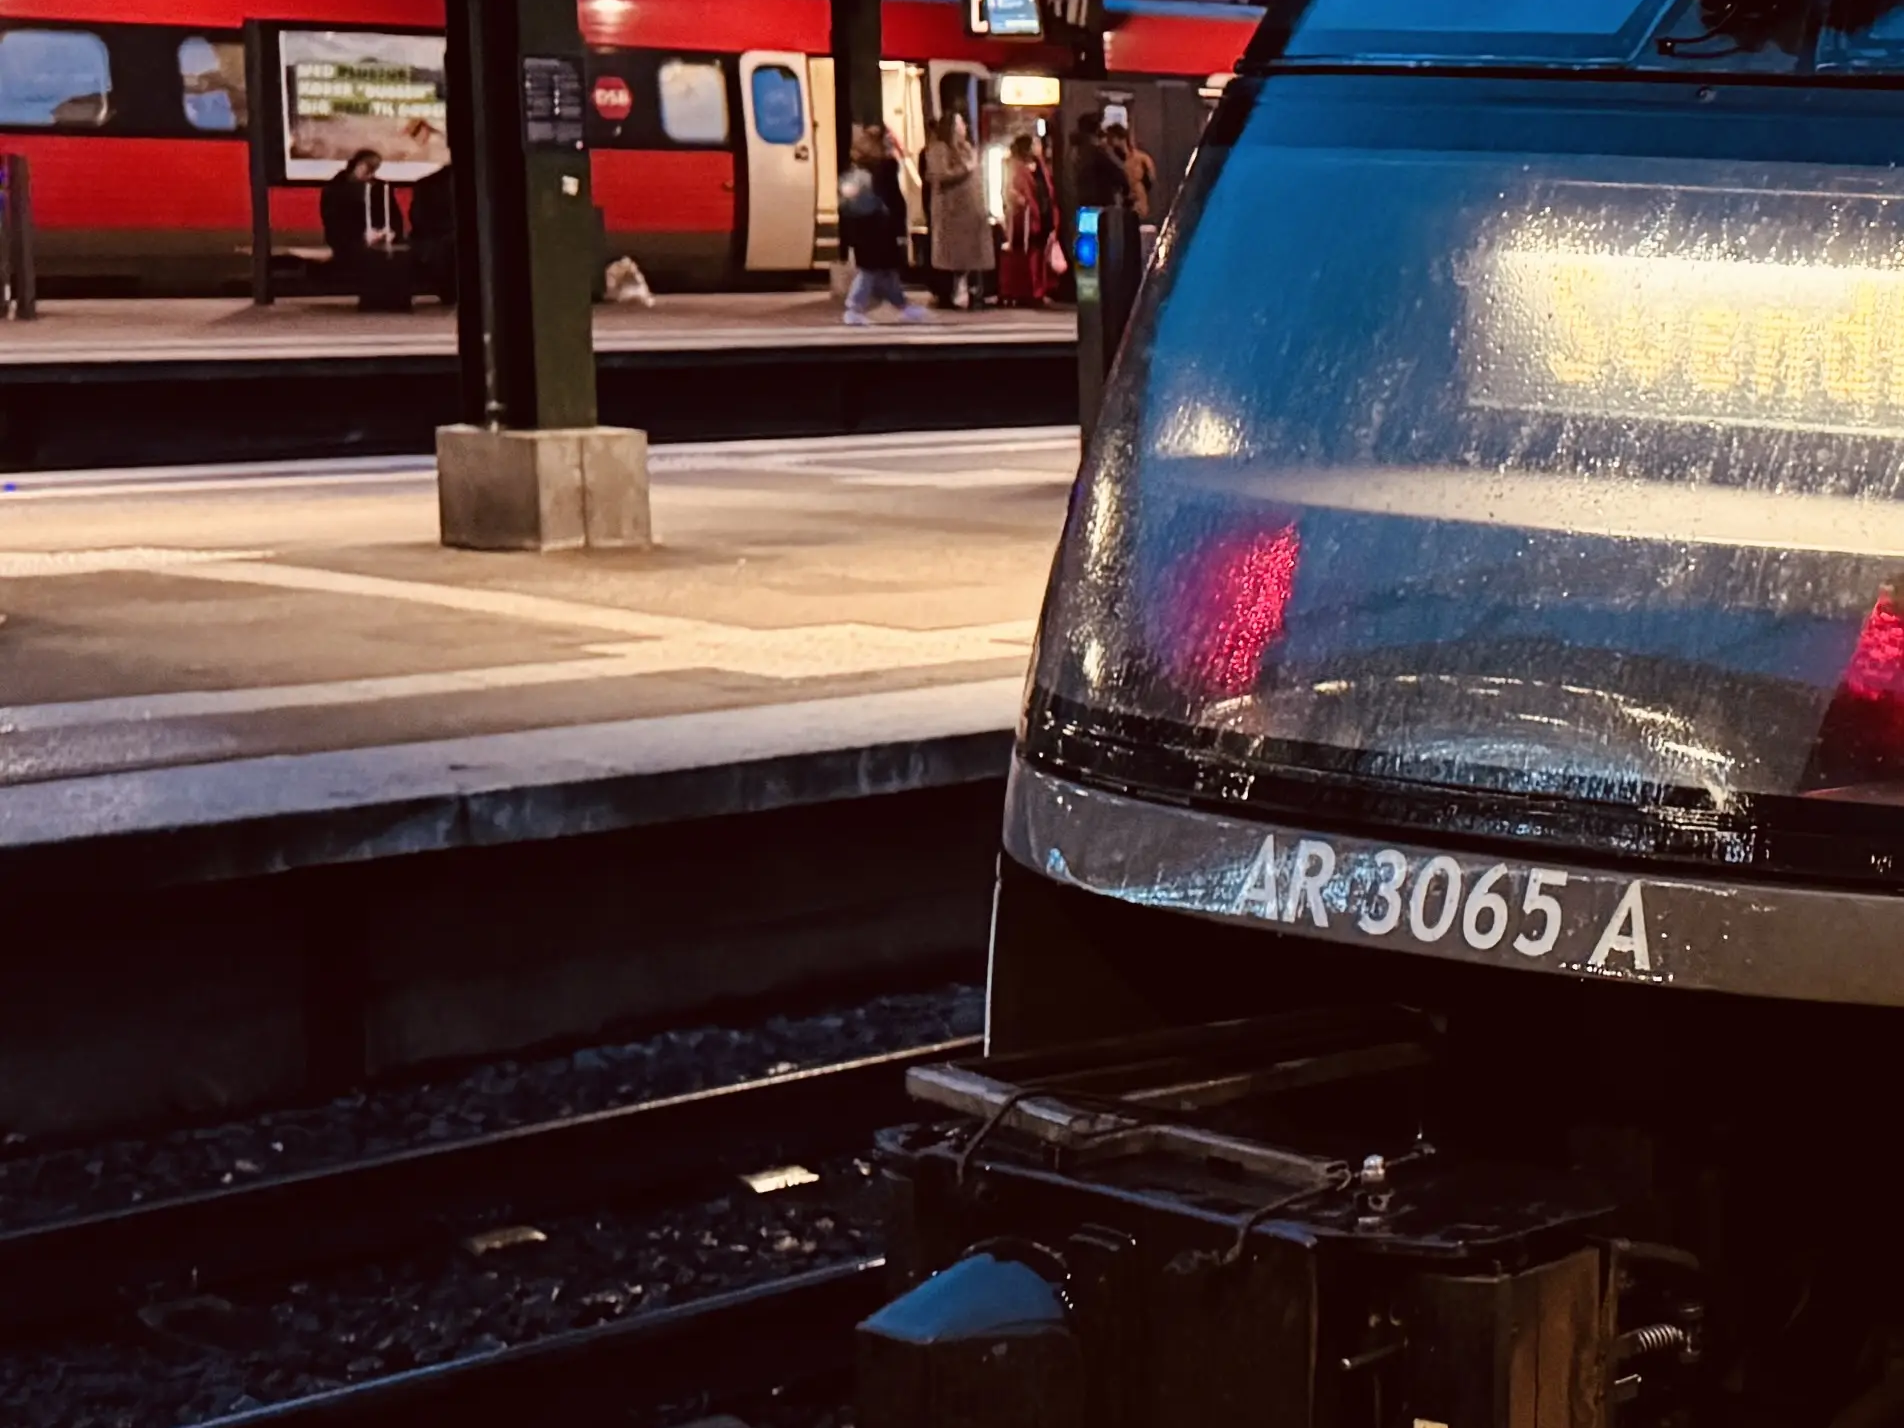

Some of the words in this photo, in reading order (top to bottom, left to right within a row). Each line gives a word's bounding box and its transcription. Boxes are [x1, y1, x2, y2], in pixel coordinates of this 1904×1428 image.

[595, 89, 630, 106] DSB
[1236, 833, 1336, 929] AR
[1357, 849, 1569, 957] 3065
[1589, 879, 1652, 971] A
